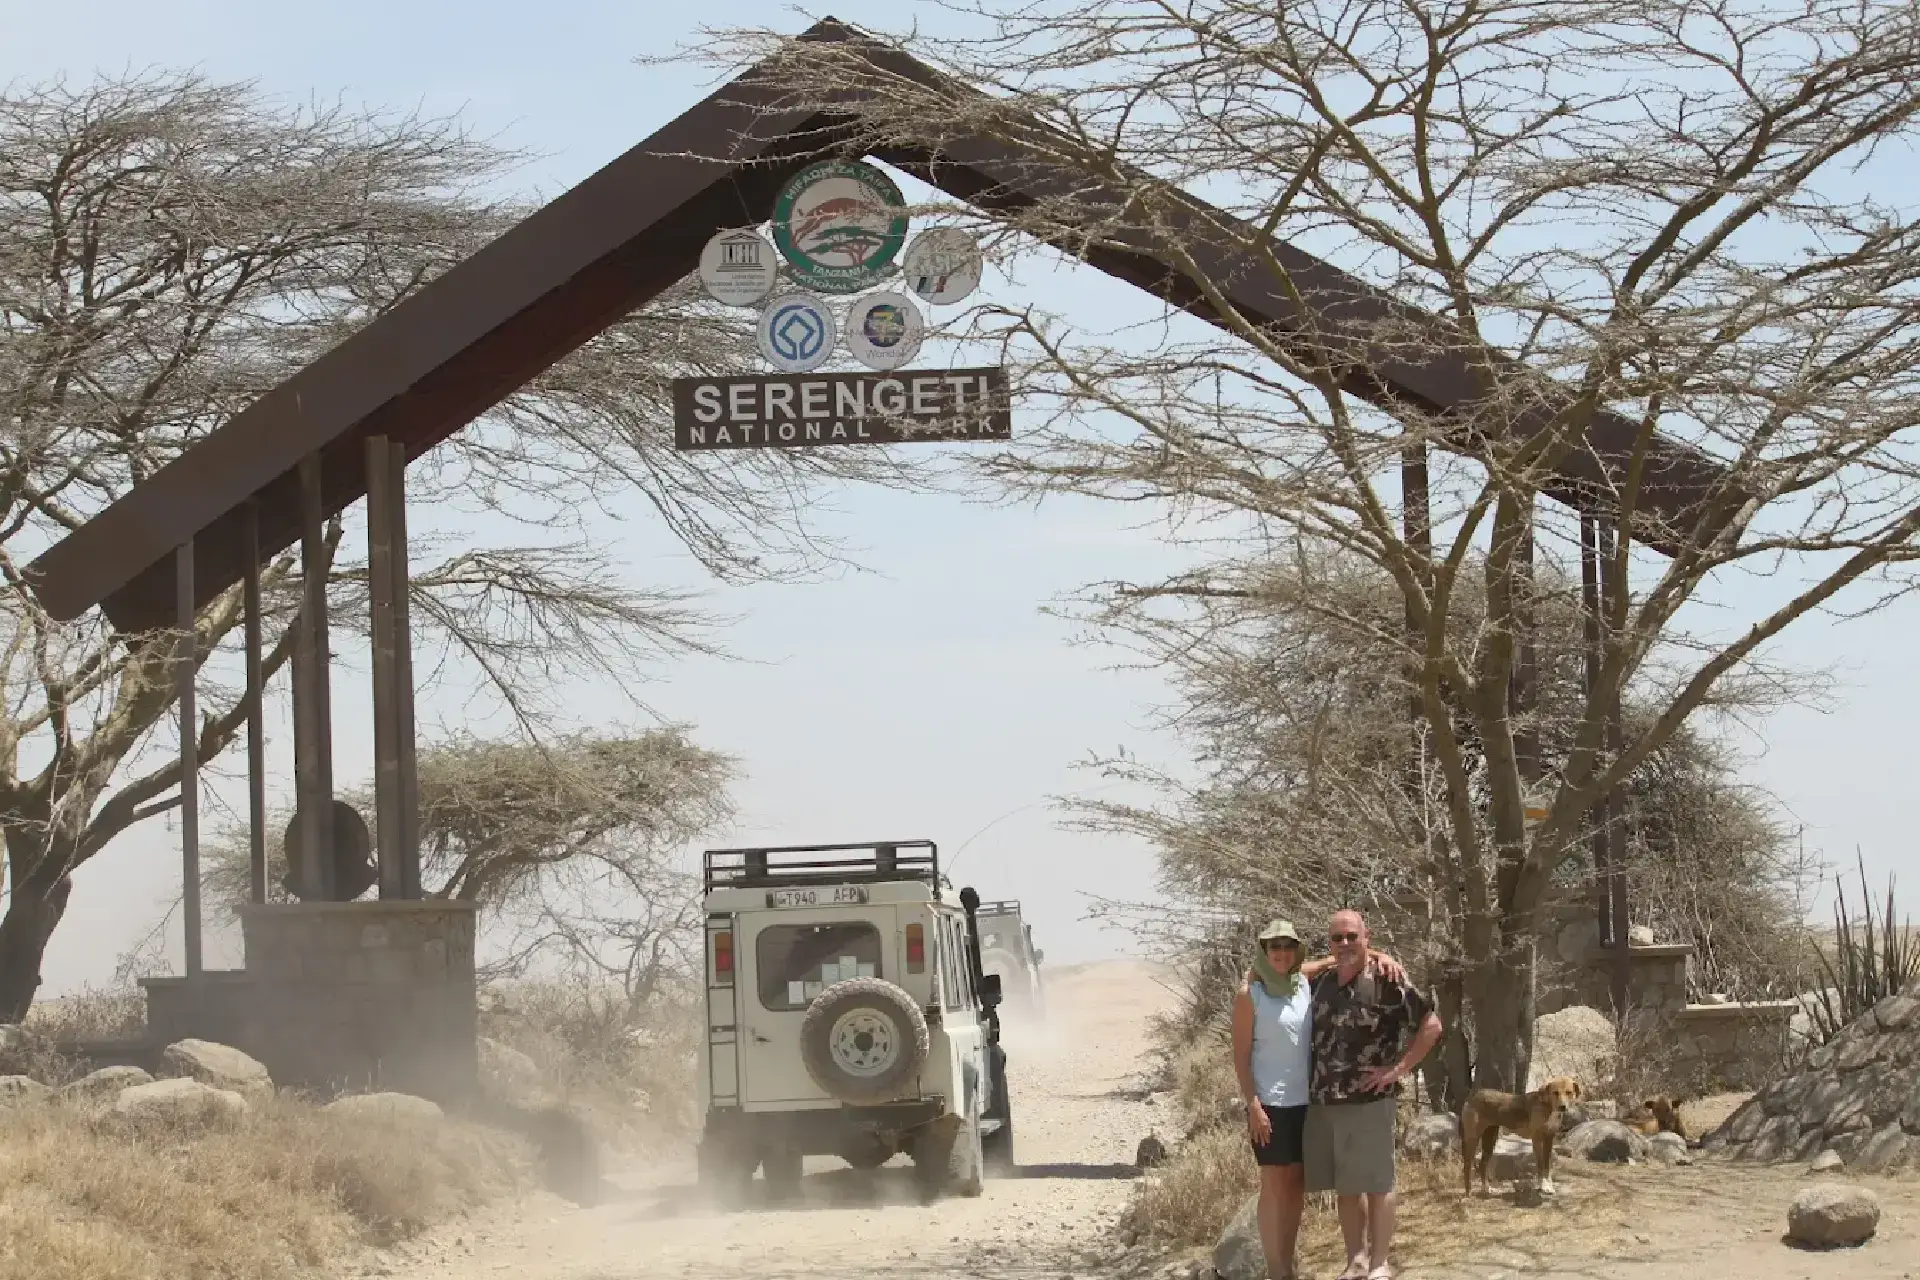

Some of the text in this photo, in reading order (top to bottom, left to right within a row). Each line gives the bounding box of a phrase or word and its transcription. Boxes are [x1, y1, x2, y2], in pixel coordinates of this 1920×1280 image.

[812, 264, 870, 278] TANZANIA
[693, 375, 989, 423] SERENGETI
[690, 418, 871, 445] NATIONAL
